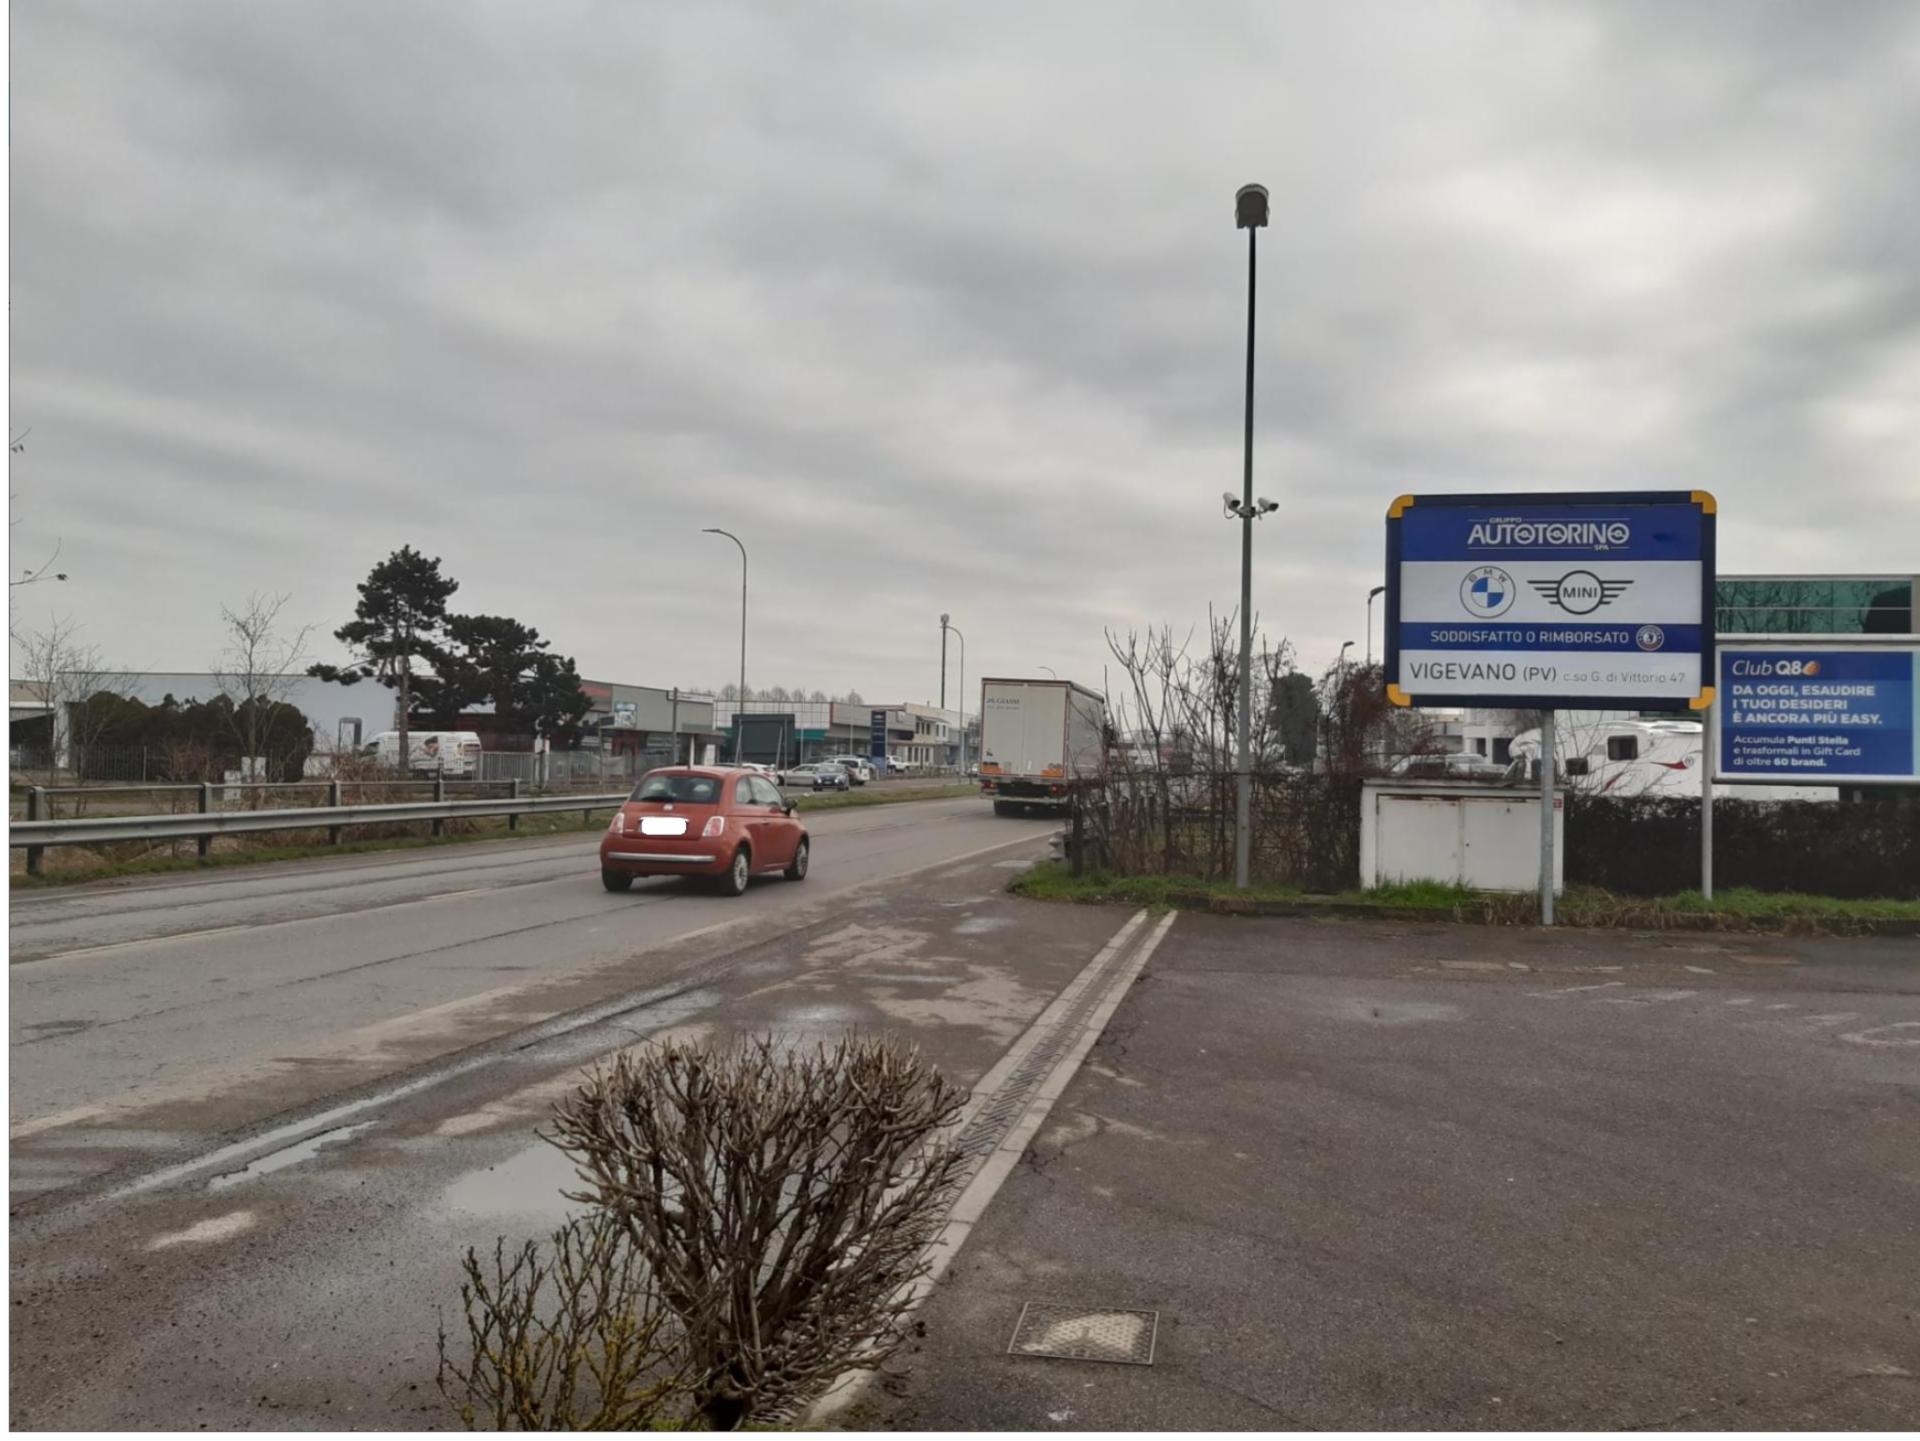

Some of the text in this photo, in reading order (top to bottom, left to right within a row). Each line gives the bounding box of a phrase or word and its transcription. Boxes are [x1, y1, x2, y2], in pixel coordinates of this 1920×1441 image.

[1467, 523, 1630, 545] AUTOTORINO
[1469, 568, 1508, 583] BMW
[1563, 587, 1598, 599] MINI
[1430, 630, 1522, 643] SODDISFATTO
[1526, 631, 1536, 643] O
[1539, 631, 1629, 644] RIMBORSATO
[1410, 662, 1516, 681] VIGEVANO
[1523, 666, 1557, 682] (PV)
[1606, 671, 1617, 682] di
[1621, 671, 1666, 684] Vittorio
[1670, 672, 1686, 684] 47
[1732, 660, 1803, 676] Club Q8
[1732, 685, 1876, 697] DA OGGI, ESAUDIRE
[1732, 699, 1848, 710] I TUOI DESIDERI
[1732, 710, 1883, 724] È ANCORA PIÙ EASY.
[1734, 735, 1849, 745] Accumula Punti Stella
[1733, 746, 1861, 756] e trasformali in Gift Card
[1733, 757, 1744, 766] di
[1746, 758, 1771, 766] oltre
[1791, 758, 1827, 767] brand.
